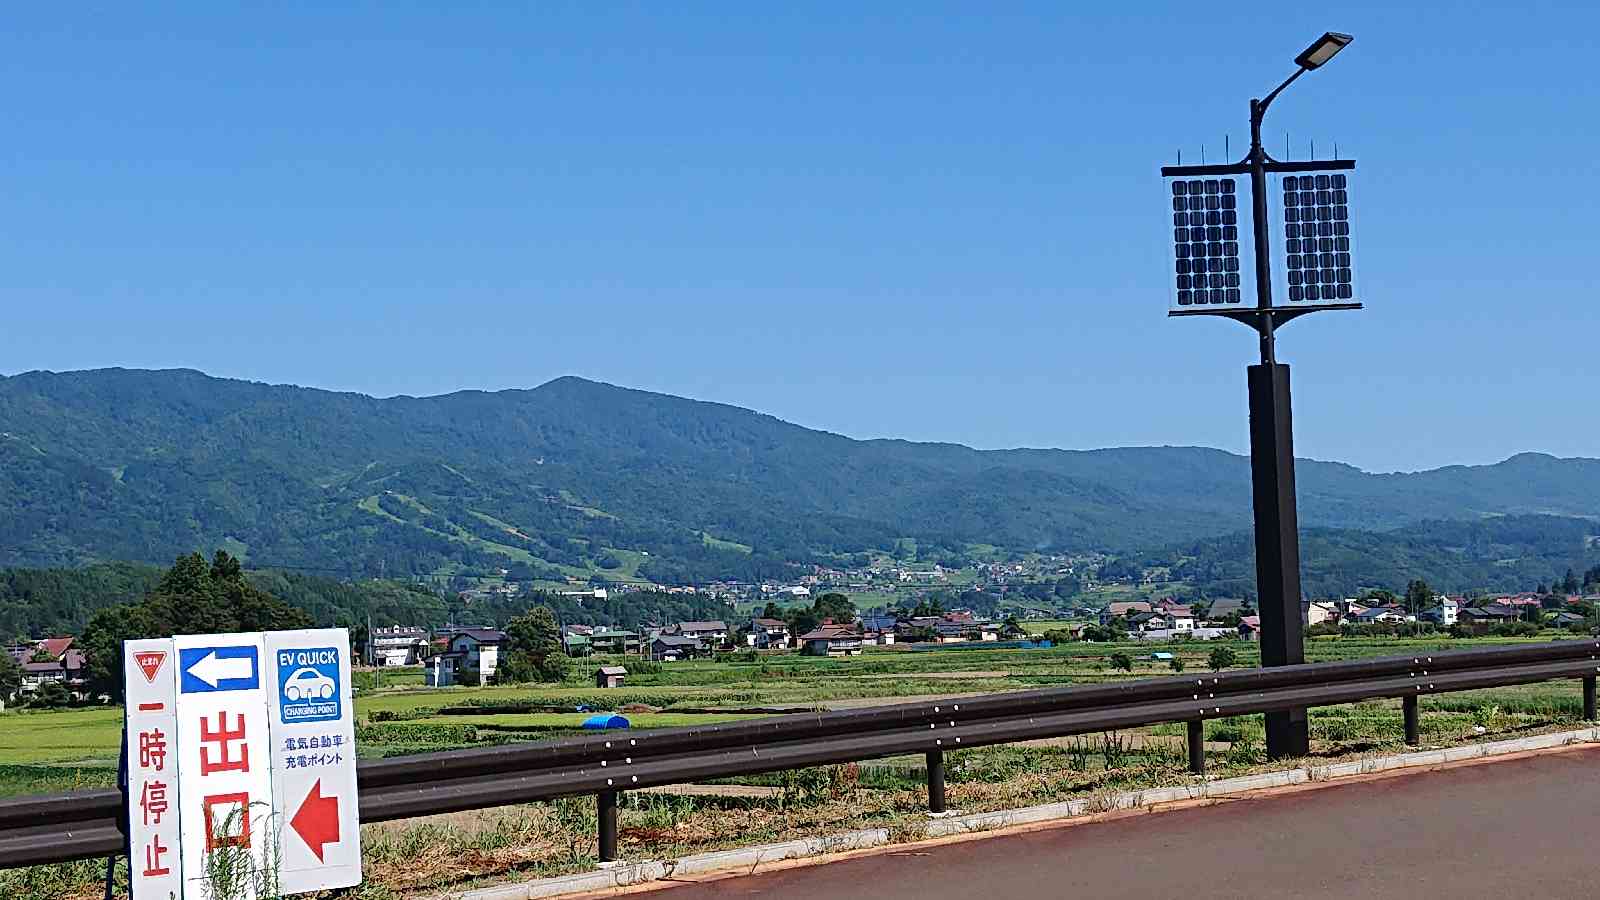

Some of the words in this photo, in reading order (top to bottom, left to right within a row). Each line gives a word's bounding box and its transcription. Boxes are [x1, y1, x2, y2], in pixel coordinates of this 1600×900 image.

[280, 652, 294, 666] EV
[297, 650, 336, 665] QUICK
[318, 705, 336, 714] POINT
[284, 734, 343, 751] 電気自動車
[285, 752, 342, 769] 充電ポイント
[139, 702, 170, 876] 一時停止
[200, 711, 250, 853] 出口
